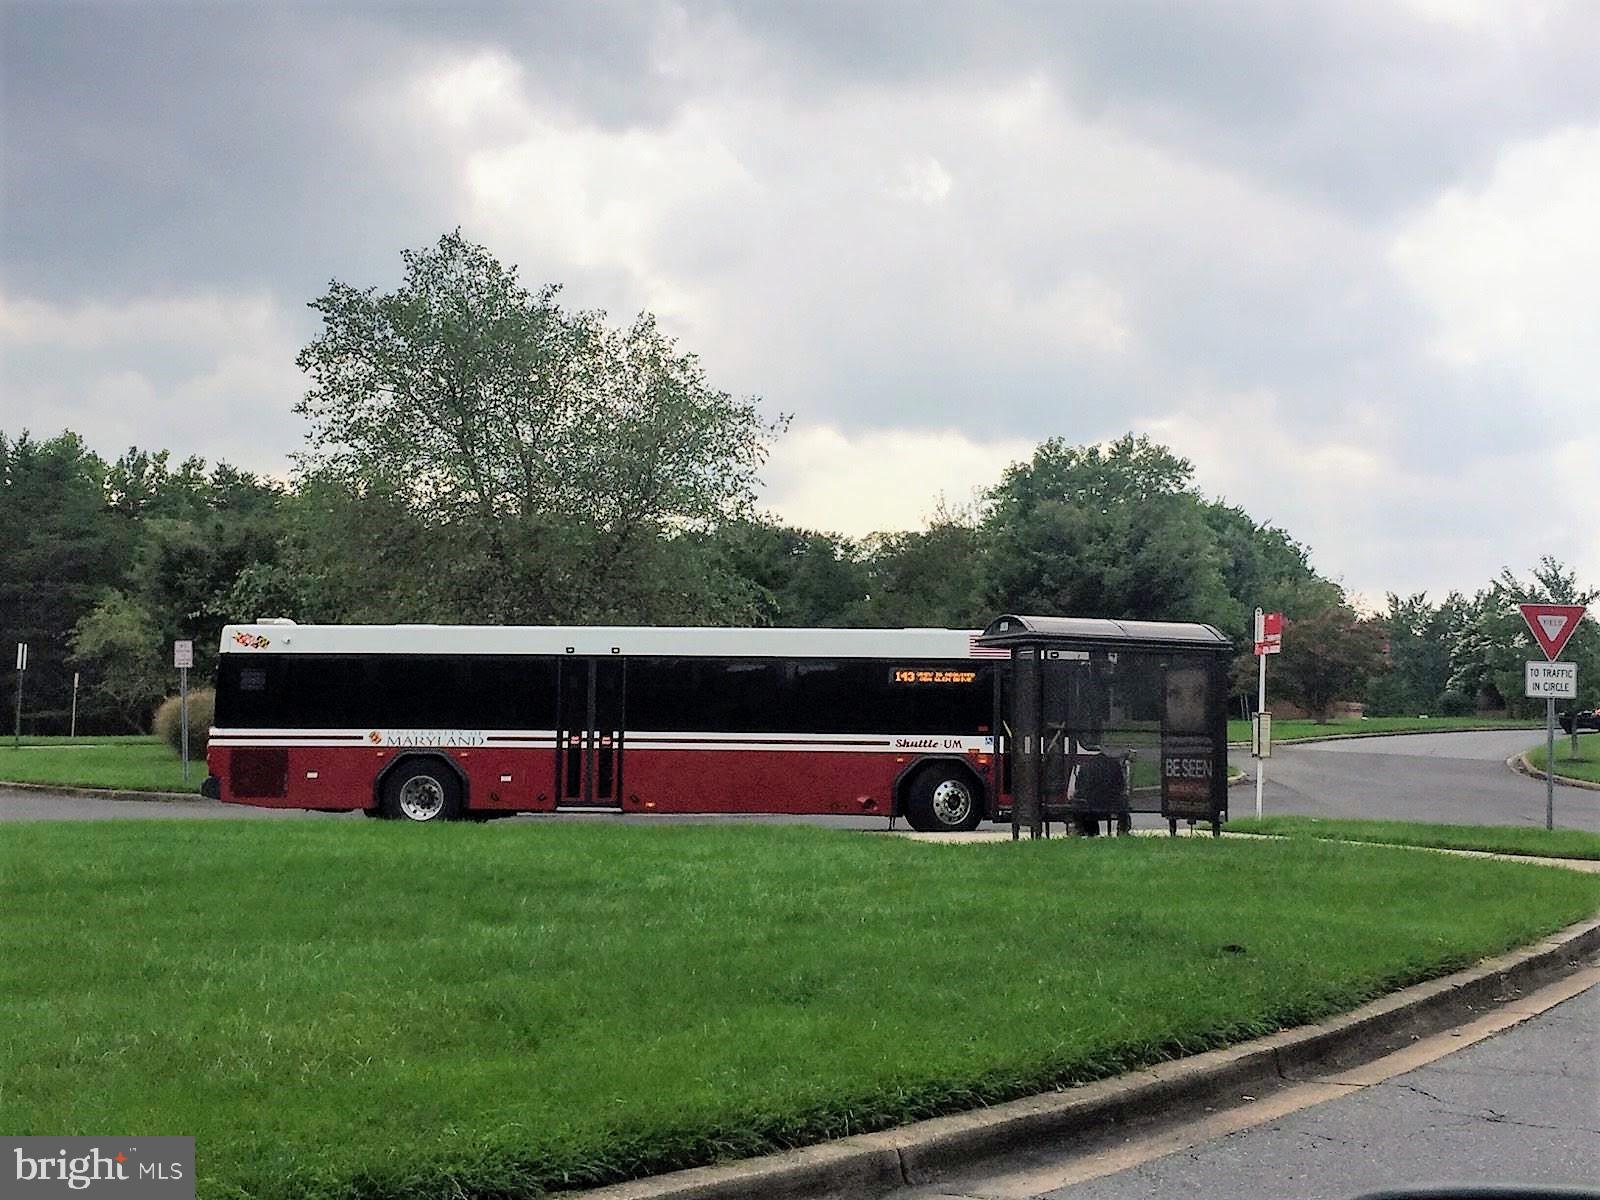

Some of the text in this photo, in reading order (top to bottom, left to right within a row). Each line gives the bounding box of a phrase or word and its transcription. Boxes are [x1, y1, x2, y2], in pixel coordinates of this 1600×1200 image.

[1530, 668, 1573, 679] TO TRAFFIC
[1532, 682, 1569, 692] IN CIRCLE
[387, 736, 484, 746] MARYLAND
[1166, 758, 1213, 777] BE SEEN
